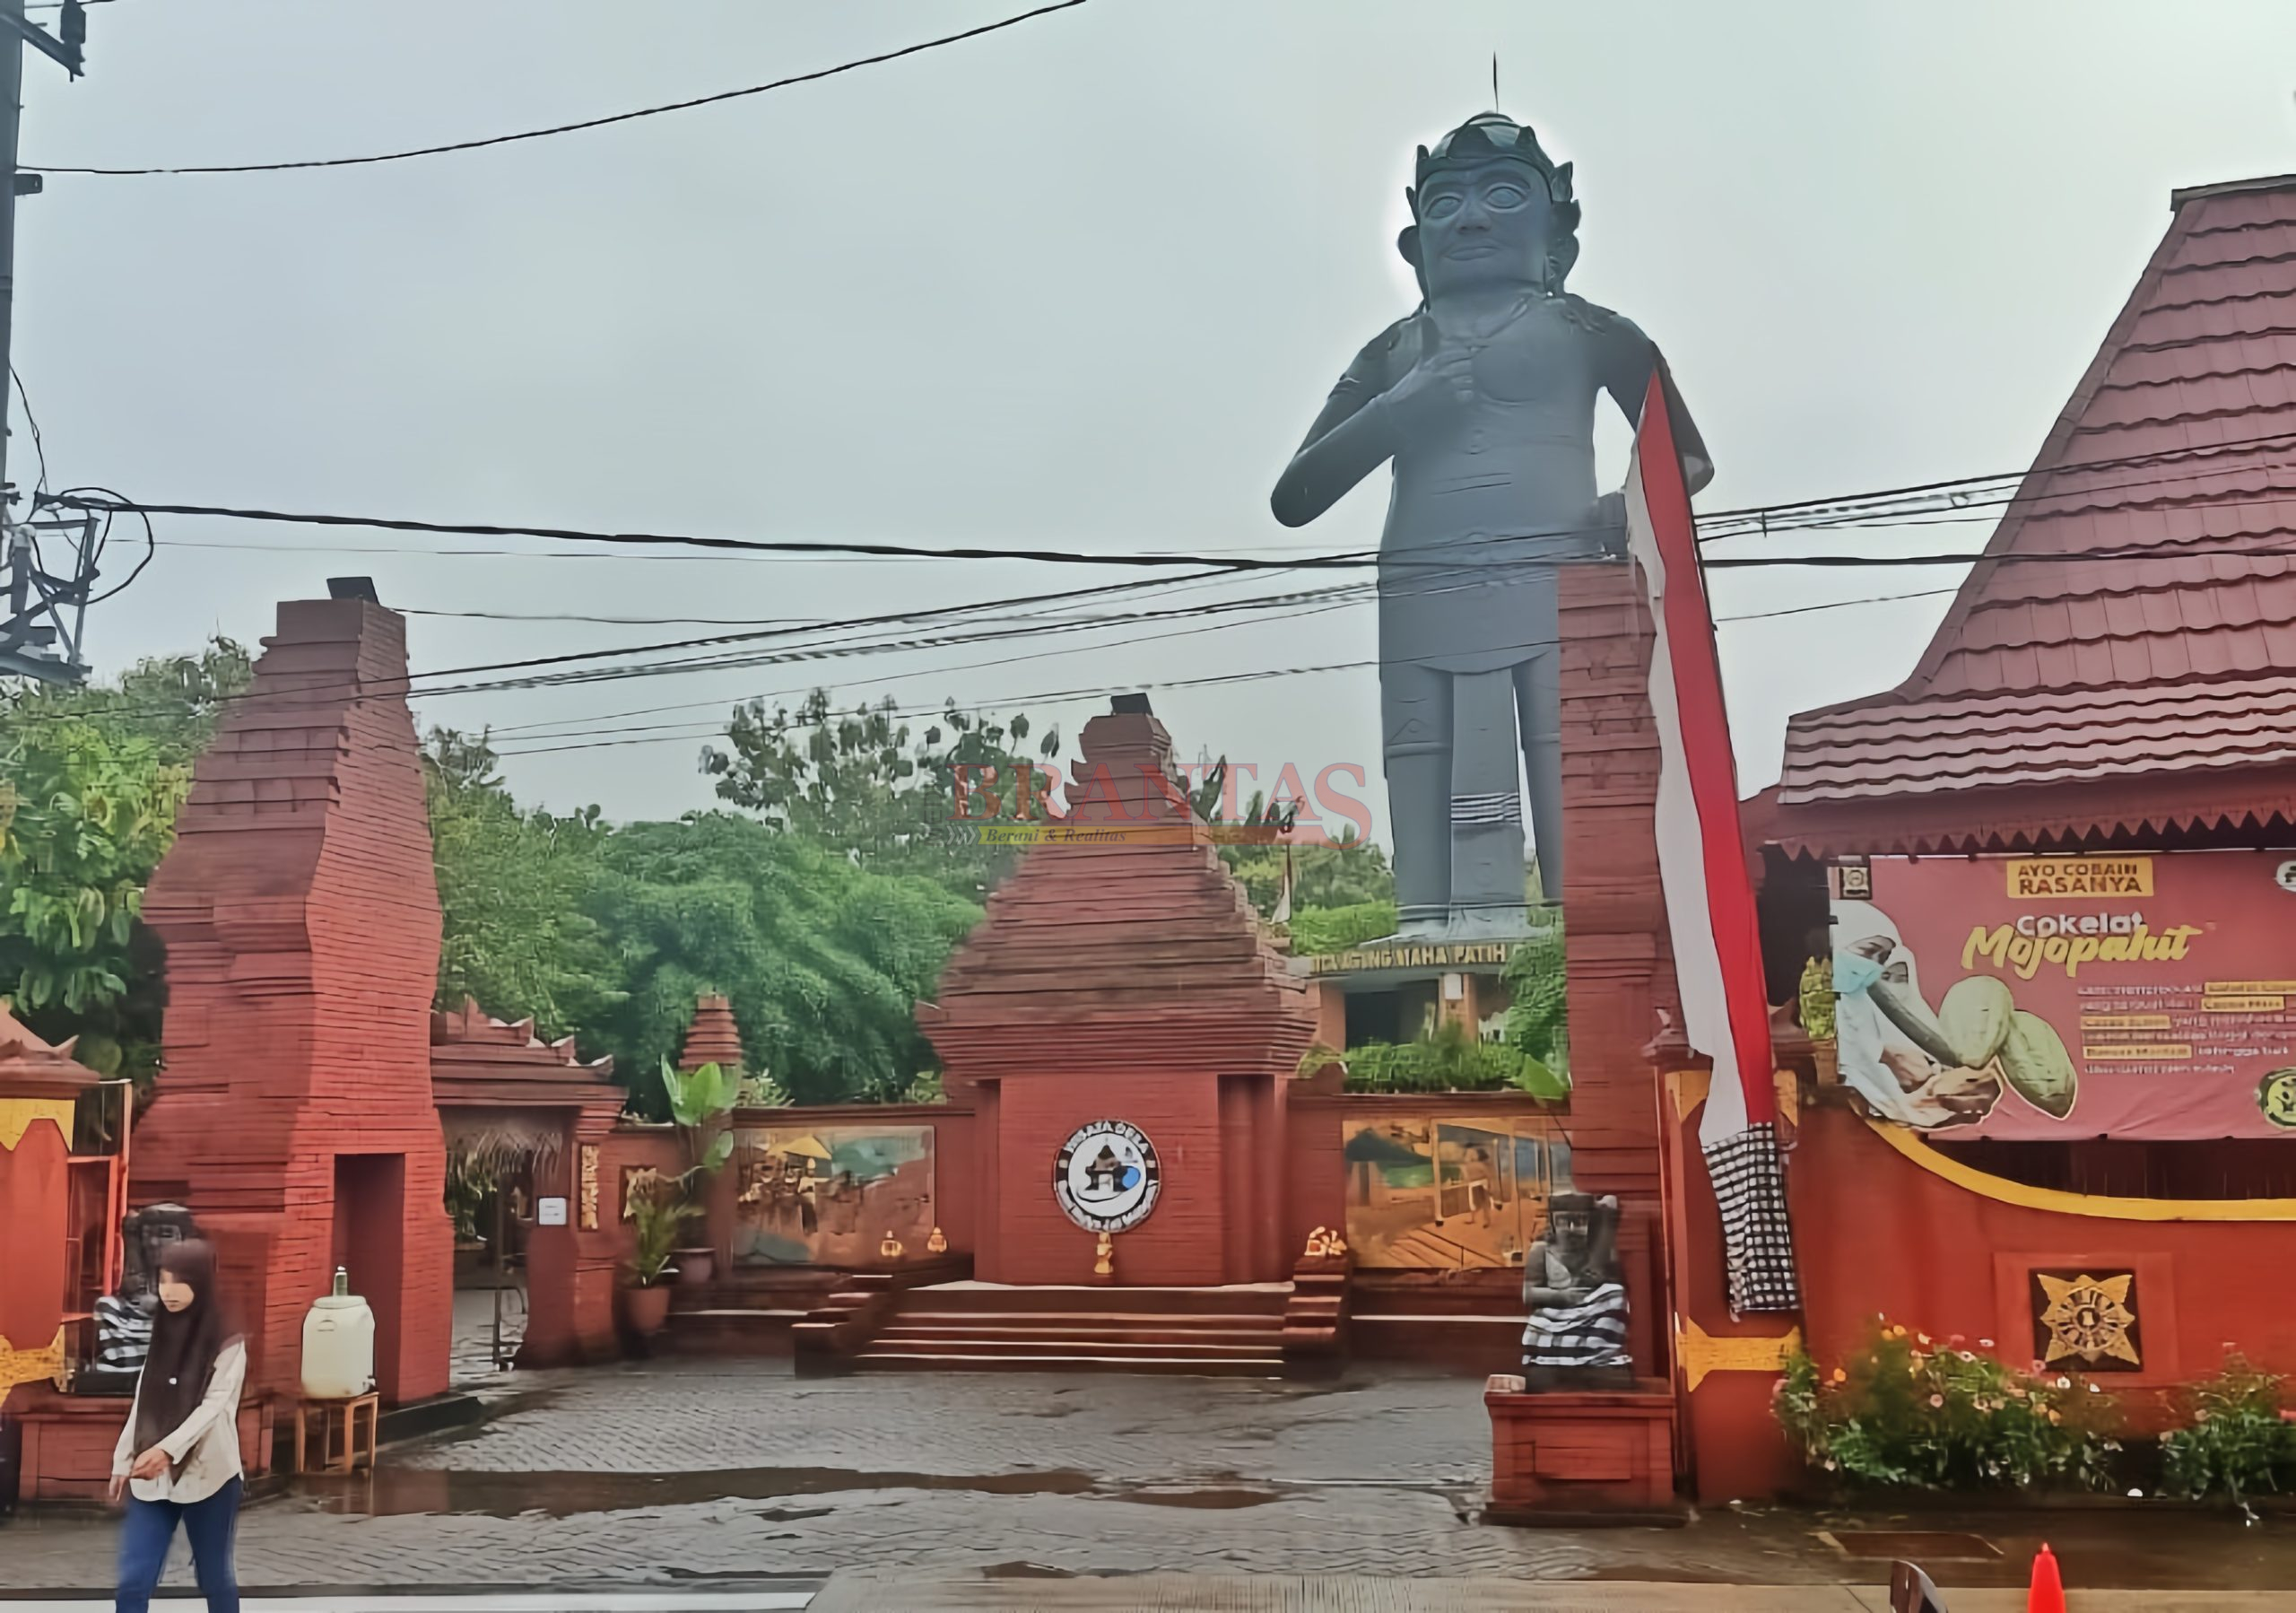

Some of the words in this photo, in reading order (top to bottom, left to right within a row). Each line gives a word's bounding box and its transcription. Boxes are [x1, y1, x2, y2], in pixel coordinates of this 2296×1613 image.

[2018, 864, 2056, 876] AYO
[2063, 863, 2137, 876] COBAIN
[2019, 876, 2143, 895] RASANYA
[2016, 911, 2145, 937] Cokelat
[1454, 943, 1506, 964] PATIH
